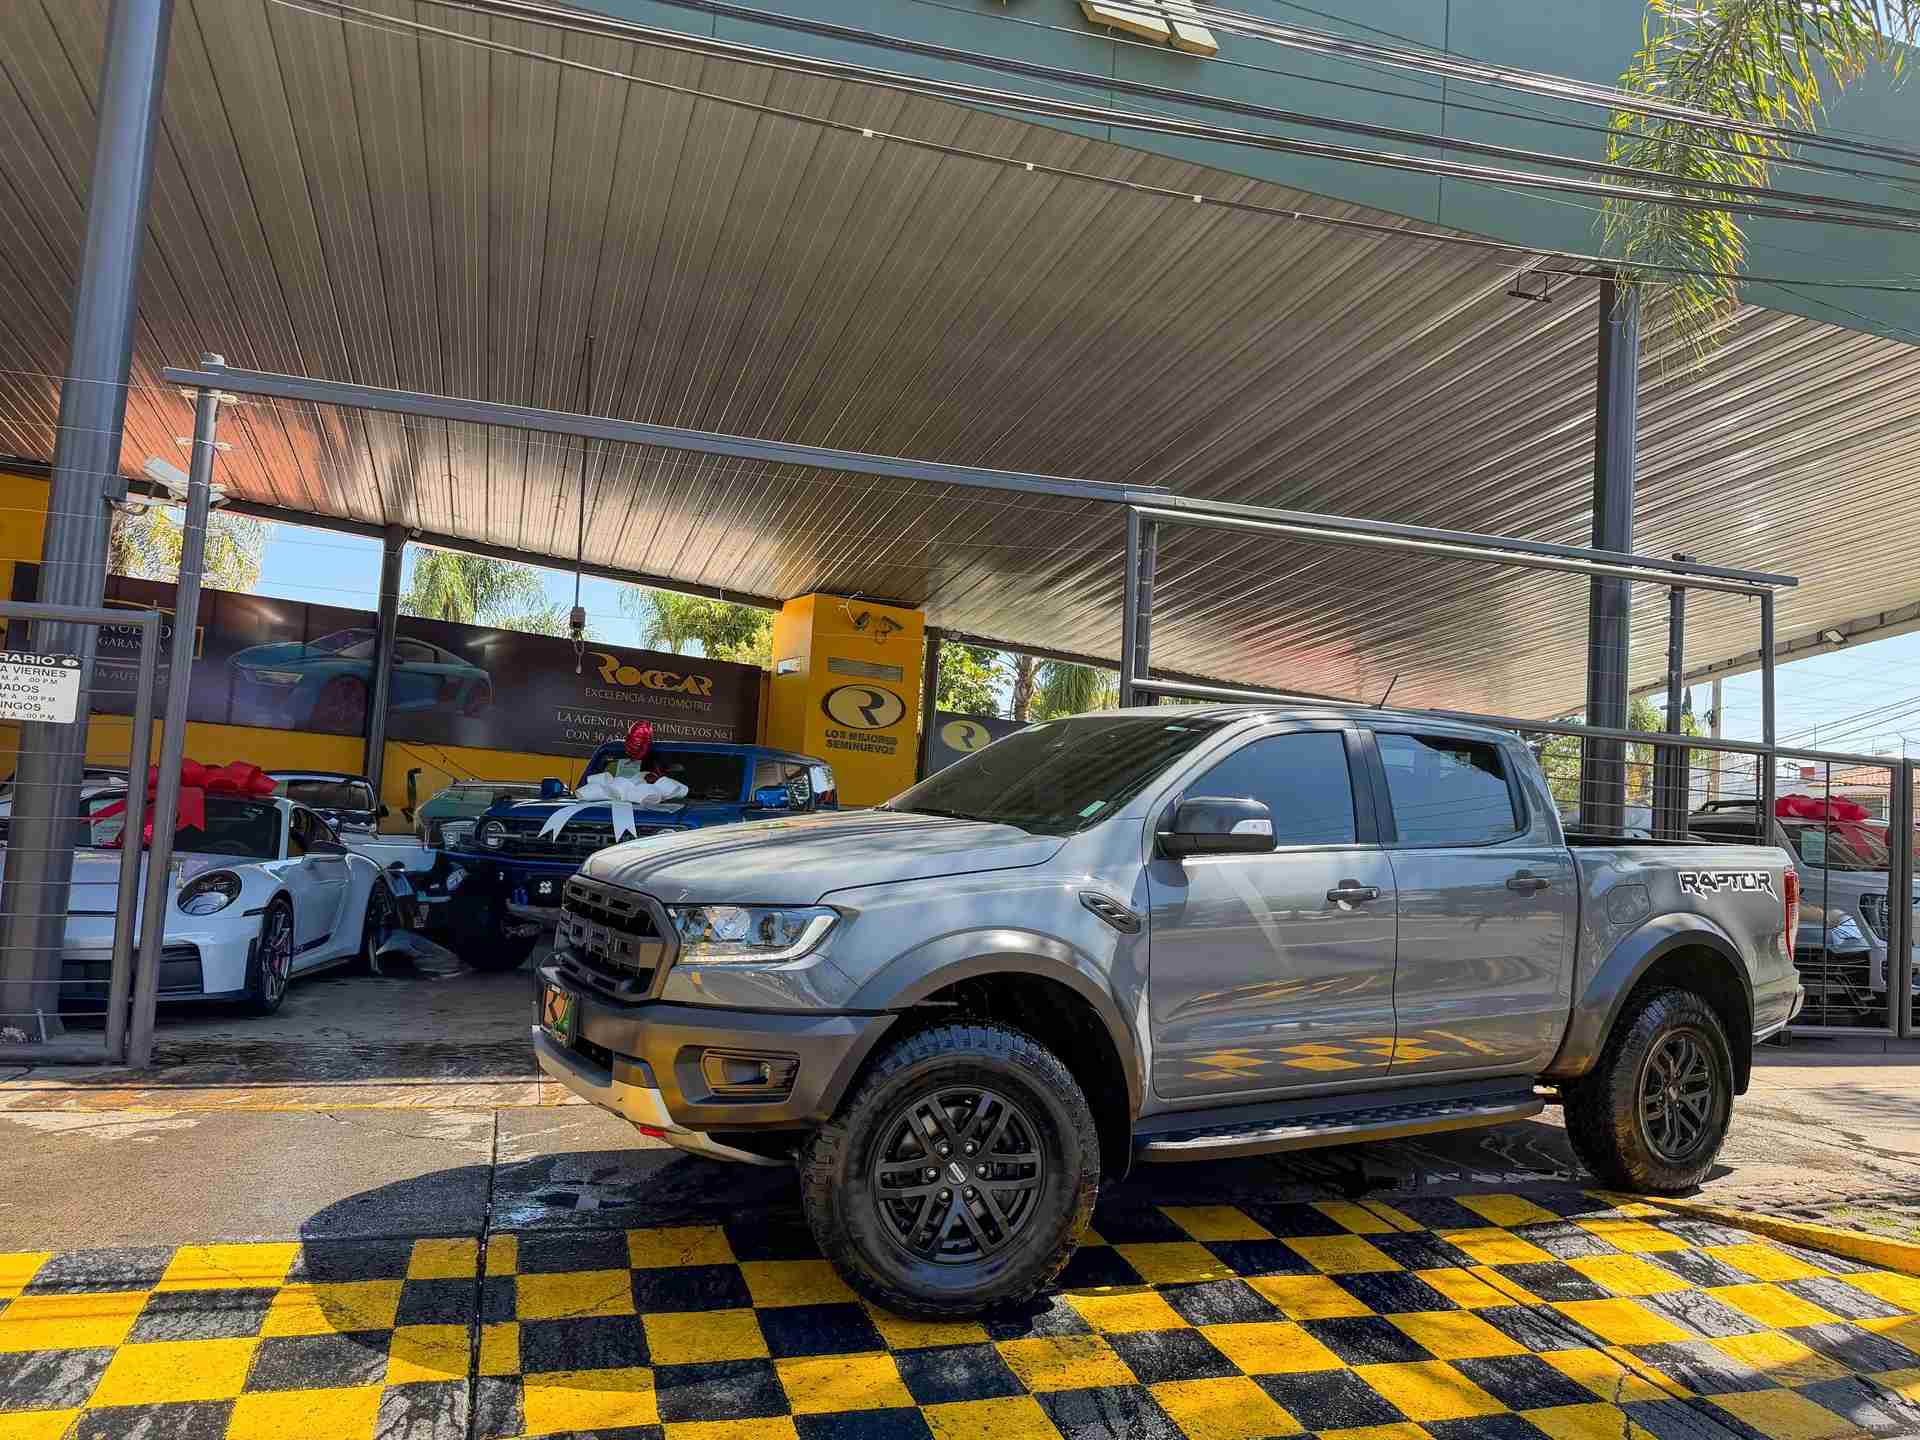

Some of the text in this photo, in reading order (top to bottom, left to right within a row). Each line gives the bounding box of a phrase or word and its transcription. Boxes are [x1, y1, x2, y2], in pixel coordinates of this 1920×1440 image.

[13, 665, 67, 678] VIERNES
[588, 652, 712, 697] ROCCAR
[0, 683, 40, 694] ADOS
[574, 712, 625, 729] AGENCIA
[651, 720, 712, 738] EMINUEVOS
[565, 728, 592, 741] CON
[825, 729, 897, 746] LOS MEJORES
[825, 740, 897, 755] SEMINUEVOS
[1678, 871, 1780, 902] RAPTOR
